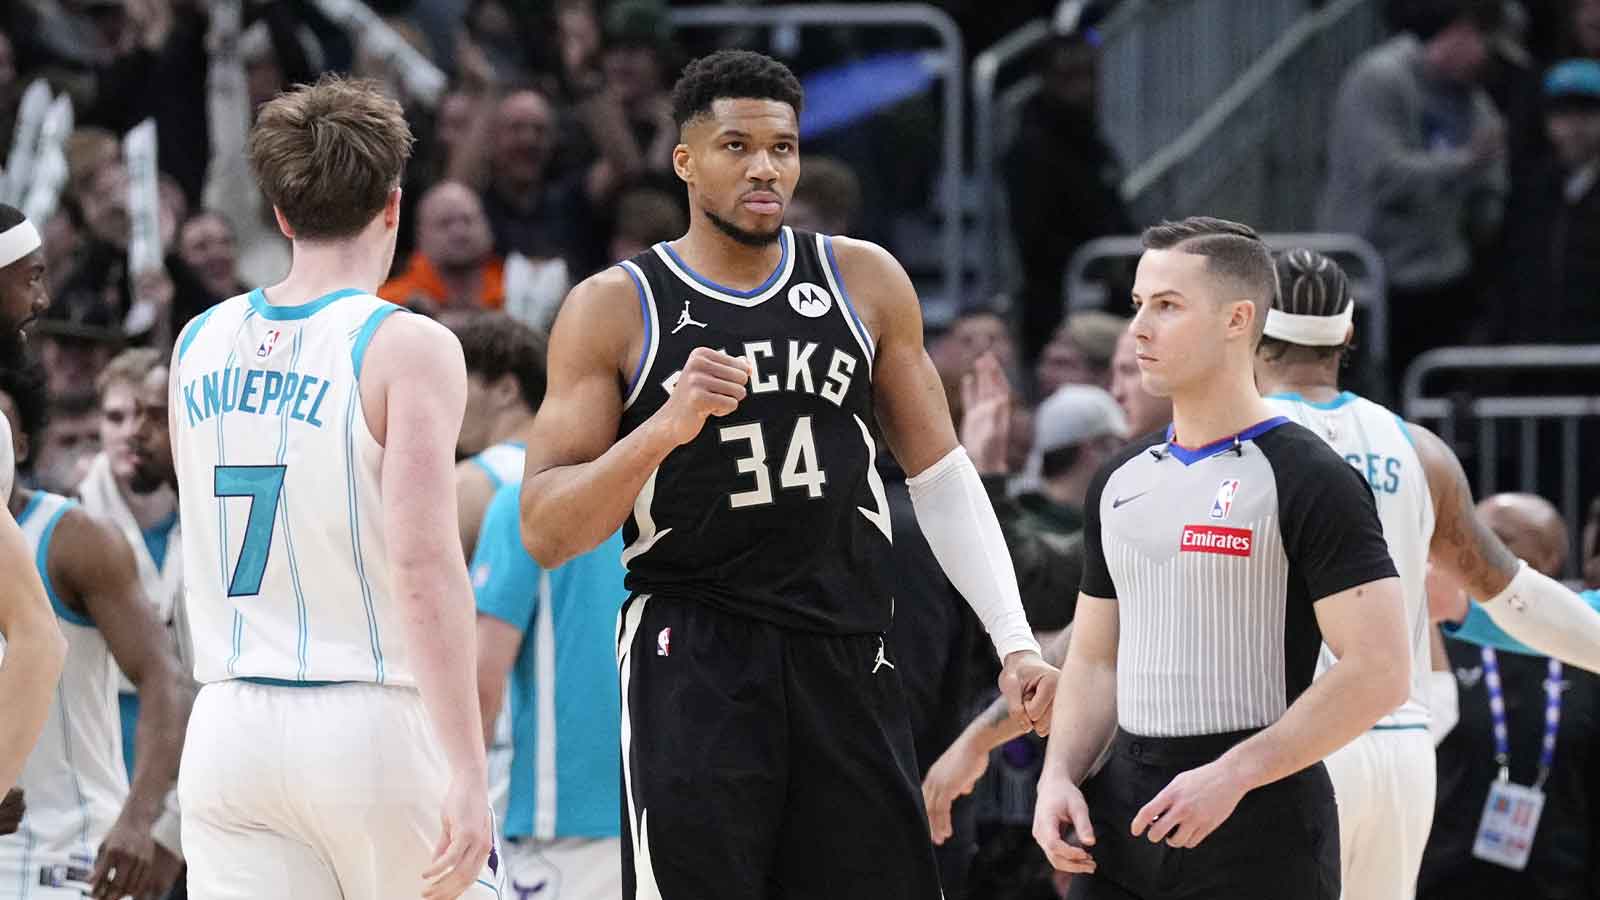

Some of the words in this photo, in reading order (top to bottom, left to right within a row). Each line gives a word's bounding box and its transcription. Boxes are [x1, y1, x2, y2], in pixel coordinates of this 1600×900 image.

[183, 367, 331, 427] KNUEPPEL
[661, 341, 857, 406] CKS
[719, 416, 826, 508] 34
[214, 464, 287, 597] 7
[1182, 530, 1250, 551] Emirates
